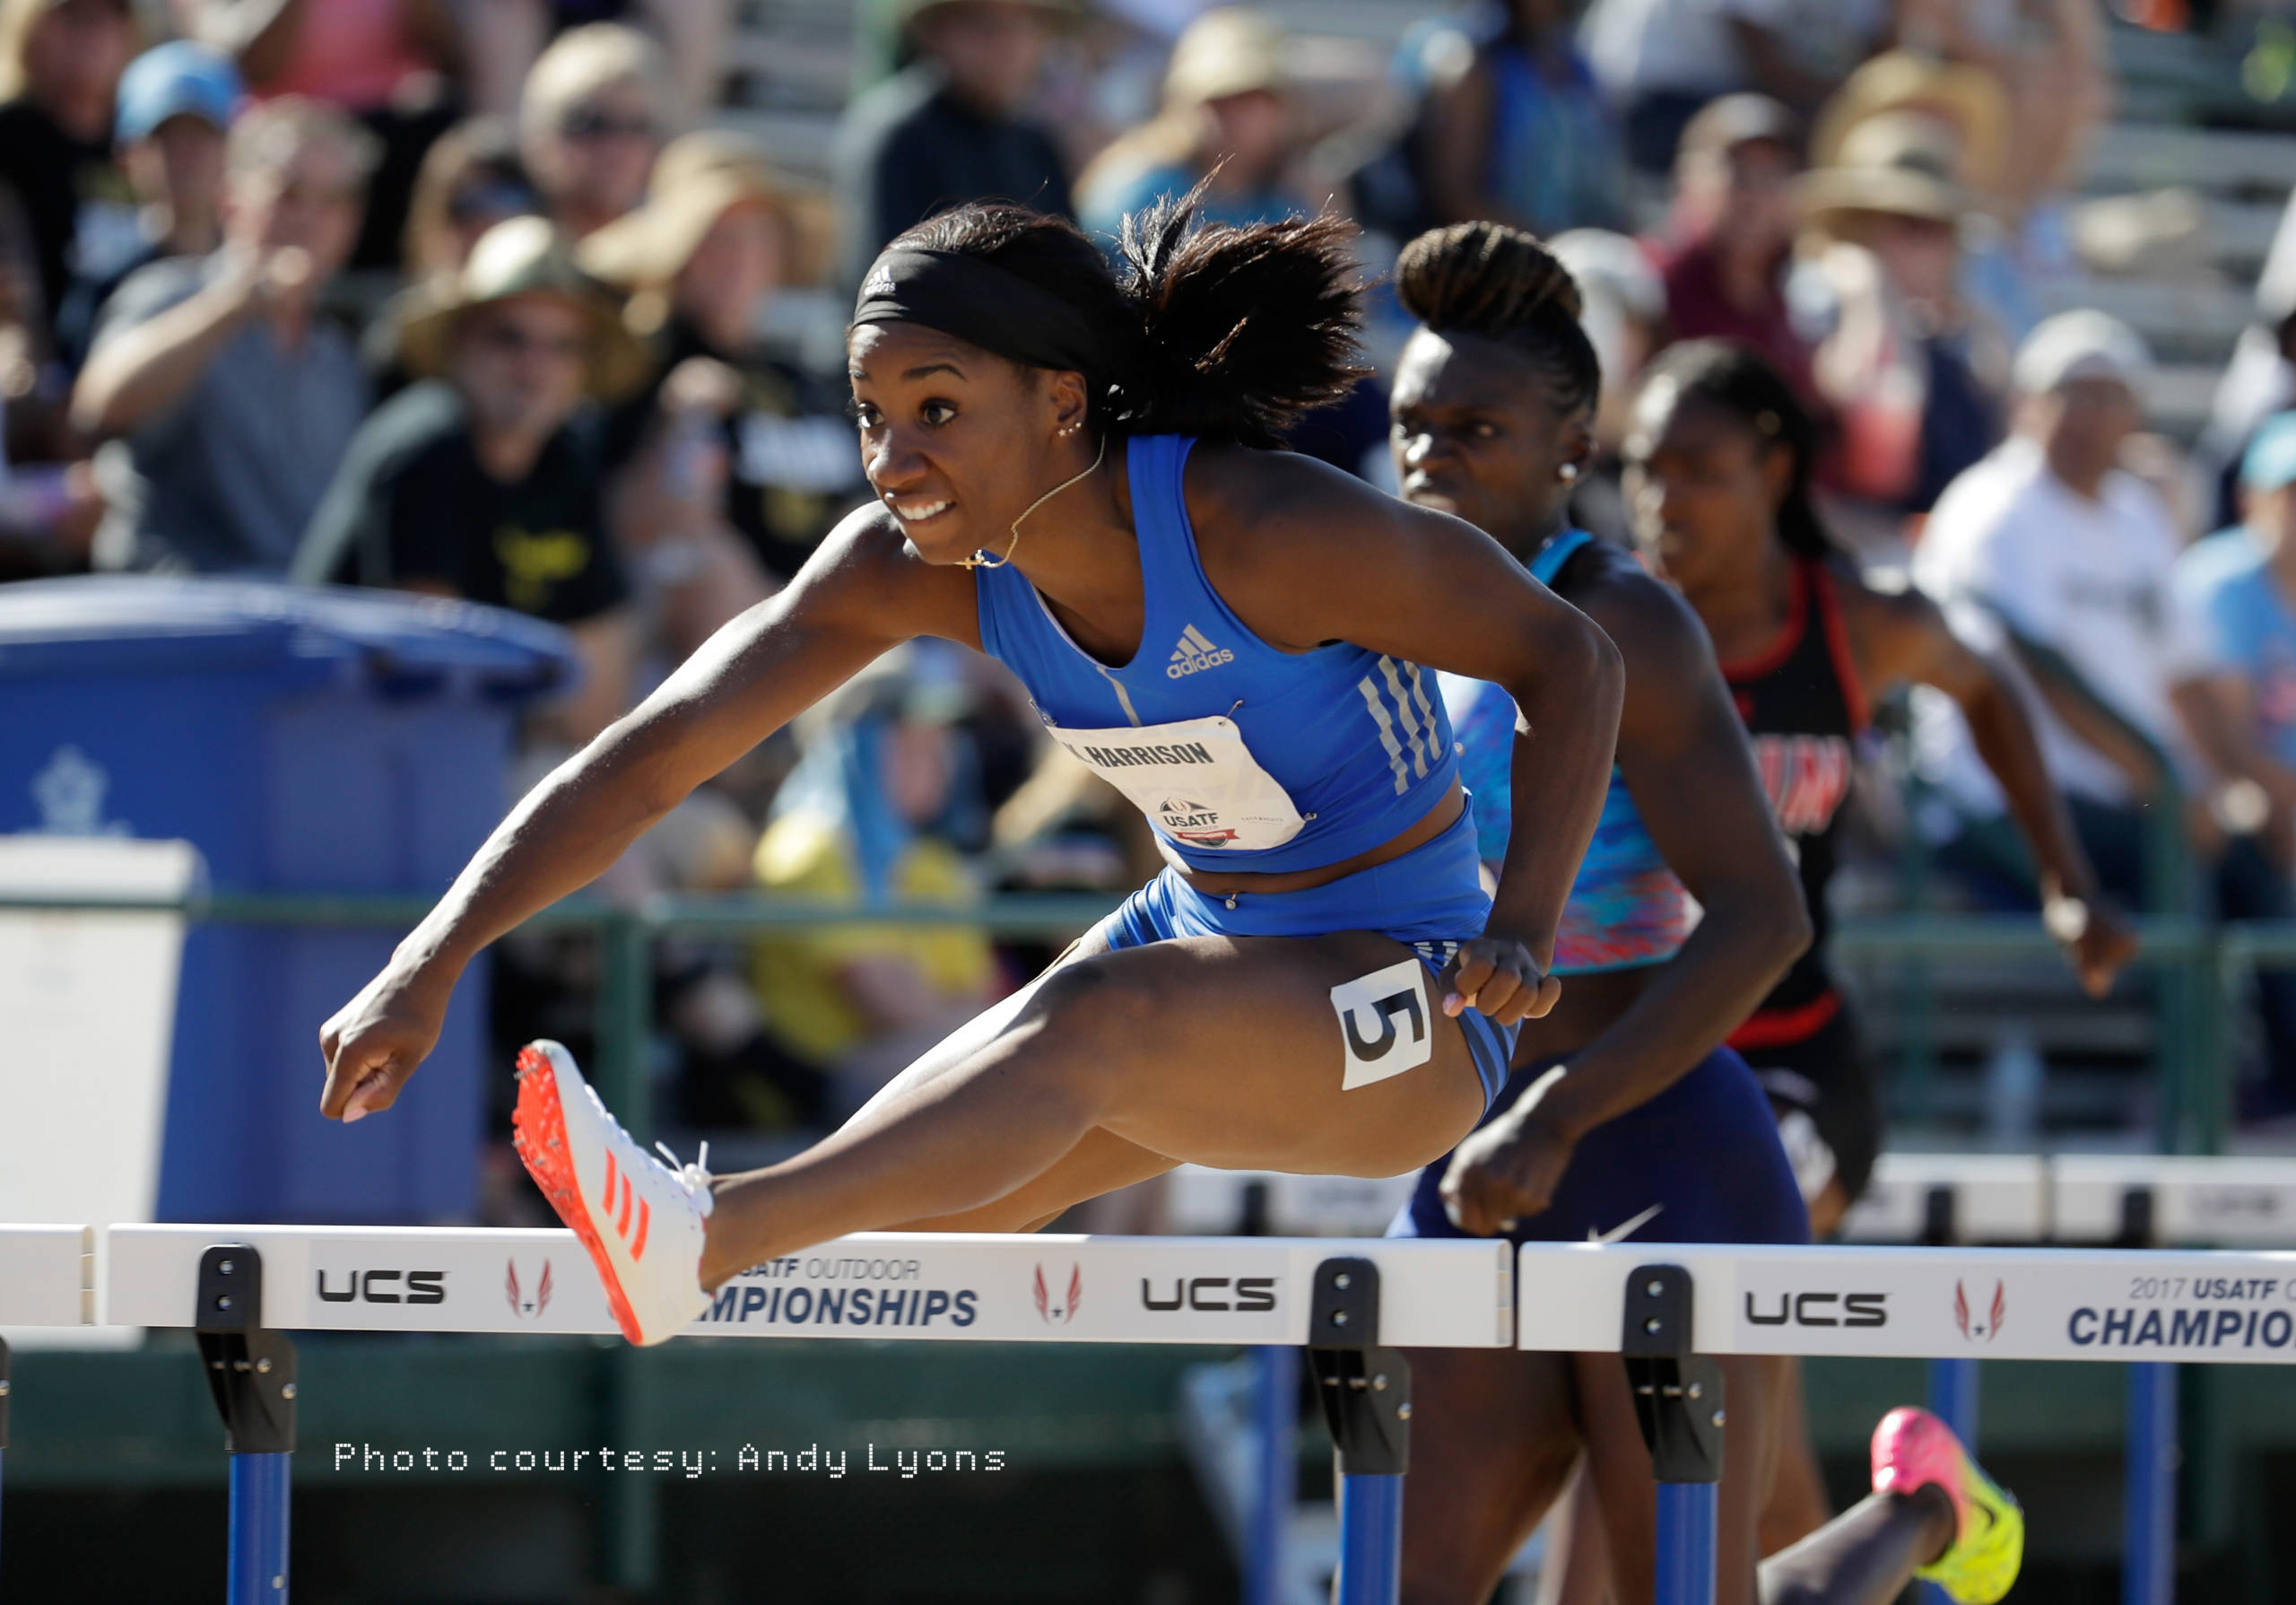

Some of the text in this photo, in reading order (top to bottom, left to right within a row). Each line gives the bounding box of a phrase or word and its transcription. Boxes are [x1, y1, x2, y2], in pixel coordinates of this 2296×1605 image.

[1166, 648, 1234, 679] adidas
[1083, 741, 1214, 768] HARRISON
[1162, 812, 1219, 827] USATF
[1343, 988, 1425, 1062] 5
[806, 1258, 920, 1280] OUTDOOR
[317, 1269, 446, 1304] UCS
[1141, 1278, 1277, 1312] UCS
[2129, 1277, 2187, 1300] 2017
[2193, 1278, 2278, 1300] USATF
[694, 1286, 978, 1327] MPIONSHIPS
[1745, 1291, 1888, 1327] UCS
[2067, 1306, 2296, 1348] CHAMPIO
